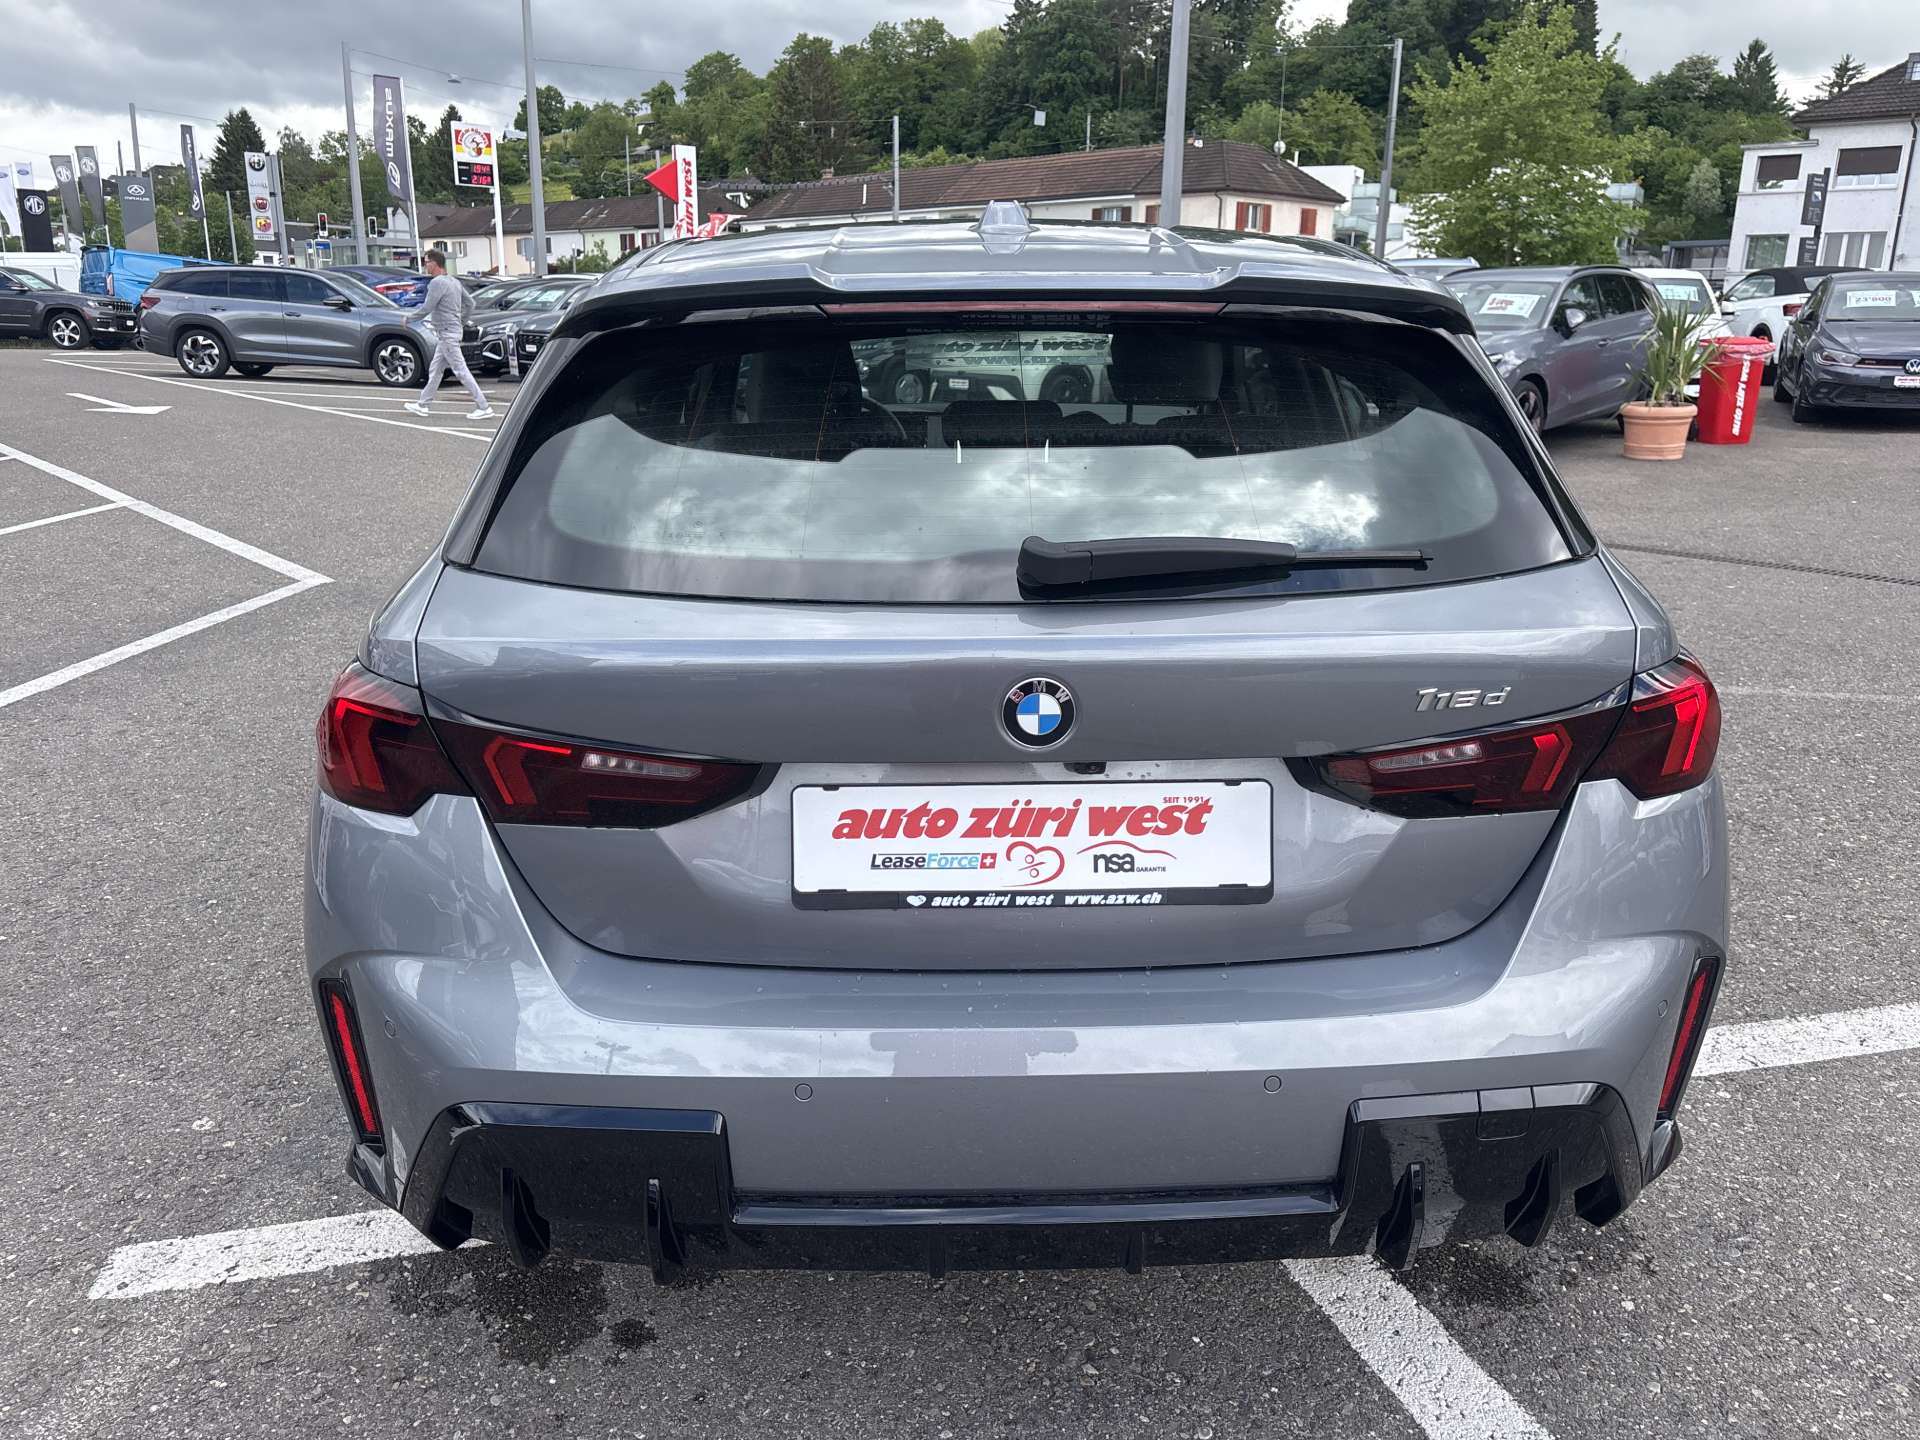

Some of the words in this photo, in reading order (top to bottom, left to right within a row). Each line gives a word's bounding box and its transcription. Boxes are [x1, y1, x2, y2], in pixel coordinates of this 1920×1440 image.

[683, 158, 692, 197] west
[25, 198, 45, 214] MG
[1043, 338, 1109, 351] west
[1732, 408, 1743, 436] auto
[1009, 680, 1070, 704] BMW
[1163, 796, 1180, 804] SEIT
[1183, 796, 1204, 804] 1991
[831, 801, 959, 839] auto
[960, 798, 1083, 838] züri
[1089, 798, 1214, 836] west
[870, 853, 979, 868] LeaseForce
[1093, 853, 1135, 873] nsa
[931, 894, 970, 907] auto
[973, 893, 1010, 906] züri
[1015, 894, 1055, 906] west
[1065, 892, 1162, 905] www.azw.ch
